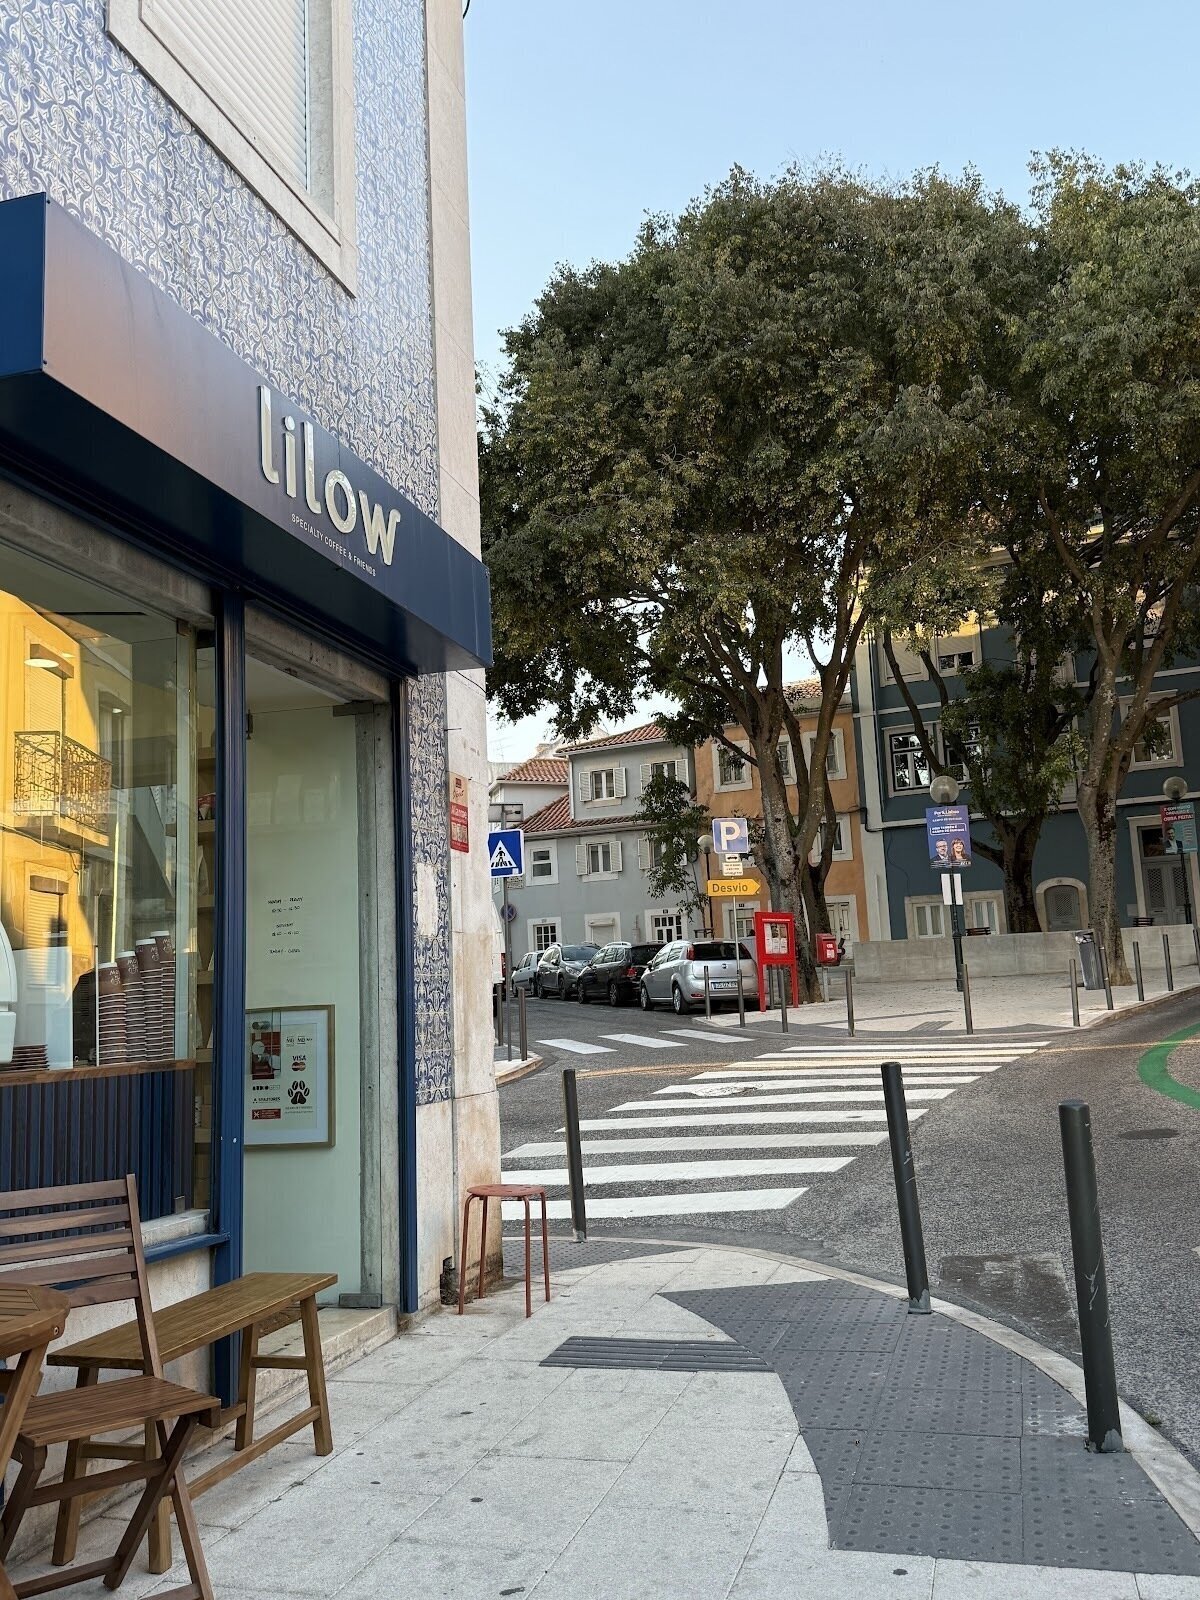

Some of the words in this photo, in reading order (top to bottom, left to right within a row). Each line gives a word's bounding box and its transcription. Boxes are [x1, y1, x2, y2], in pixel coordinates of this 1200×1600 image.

[291, 513, 324, 542] SPECIALTY
[324, 536, 347, 558] COFFEE
[348, 551, 353, 561] &
[353, 555, 377, 577] FRIENDS
[720, 821, 741, 851] P
[711, 882, 749, 894] Desvio
